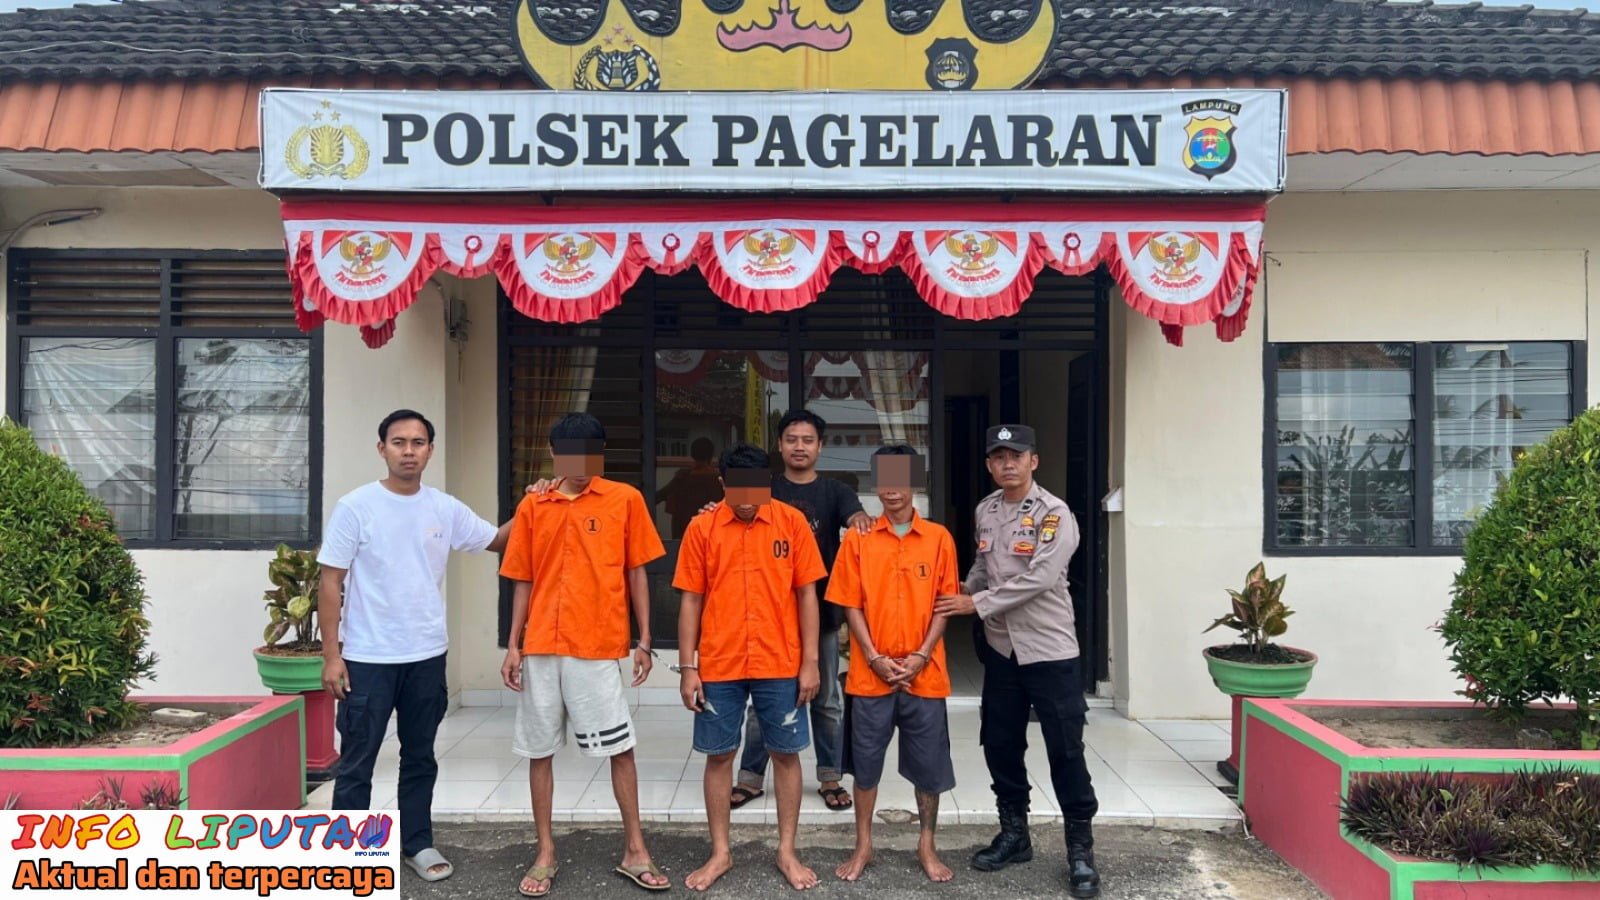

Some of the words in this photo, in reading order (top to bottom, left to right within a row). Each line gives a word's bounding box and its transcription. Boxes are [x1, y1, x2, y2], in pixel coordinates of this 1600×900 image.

[1184, 101, 1239, 114] LAMPUNG
[382, 113, 690, 167] POLSEK
[712, 114, 1162, 168] PAGELARAN
[773, 539, 790, 559] 09
